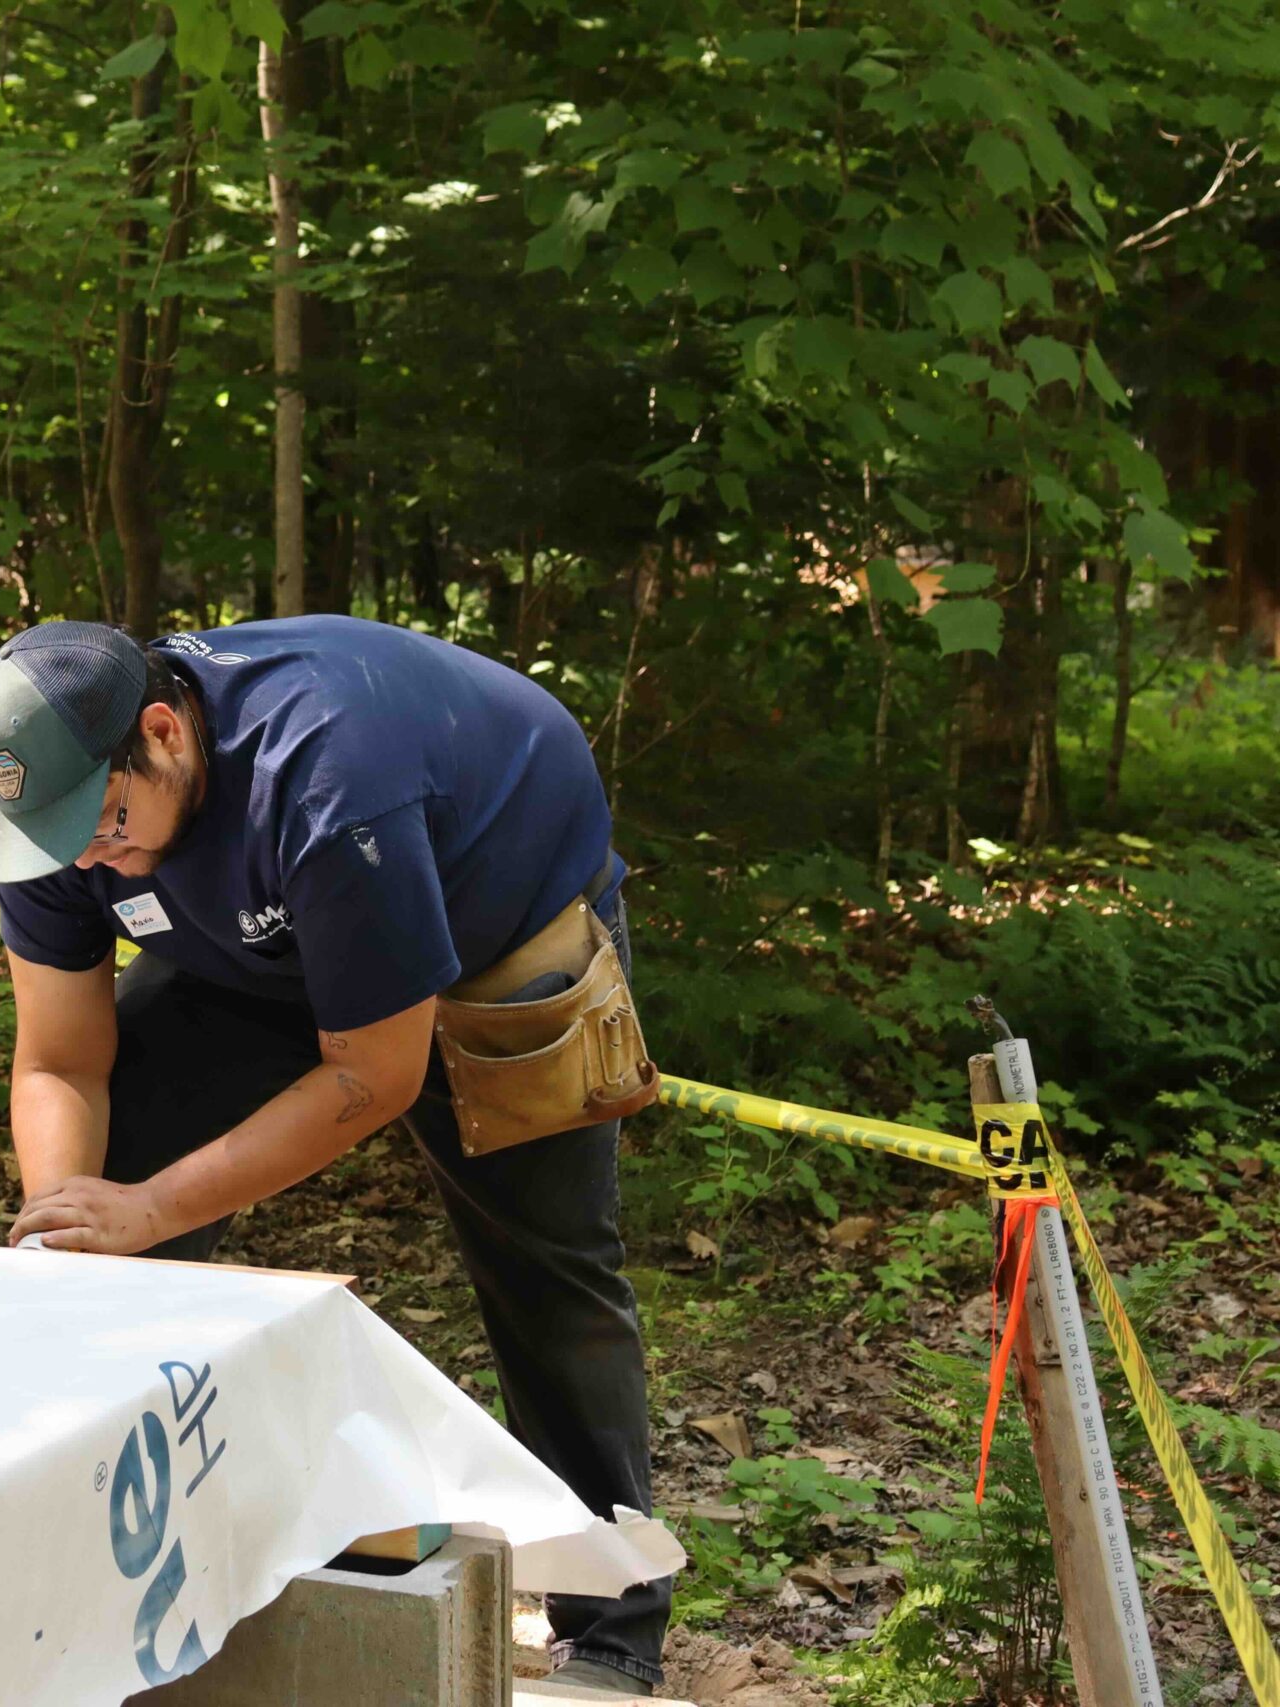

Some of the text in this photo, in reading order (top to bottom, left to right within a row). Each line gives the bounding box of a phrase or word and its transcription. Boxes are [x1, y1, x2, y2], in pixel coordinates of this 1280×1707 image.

[1054, 1273, 1068, 1306] FT-4
[1078, 1362, 1089, 1397] C22.2
[158, 1361, 227, 1499] HP
[1086, 1415, 1097, 1445] WIRE
[1094, 1457, 1105, 1482] DEG
[1099, 1485, 1109, 1500] 90
[1103, 1506, 1115, 1528] MAX
[1109, 1531, 1125, 1573] RIGIDE
